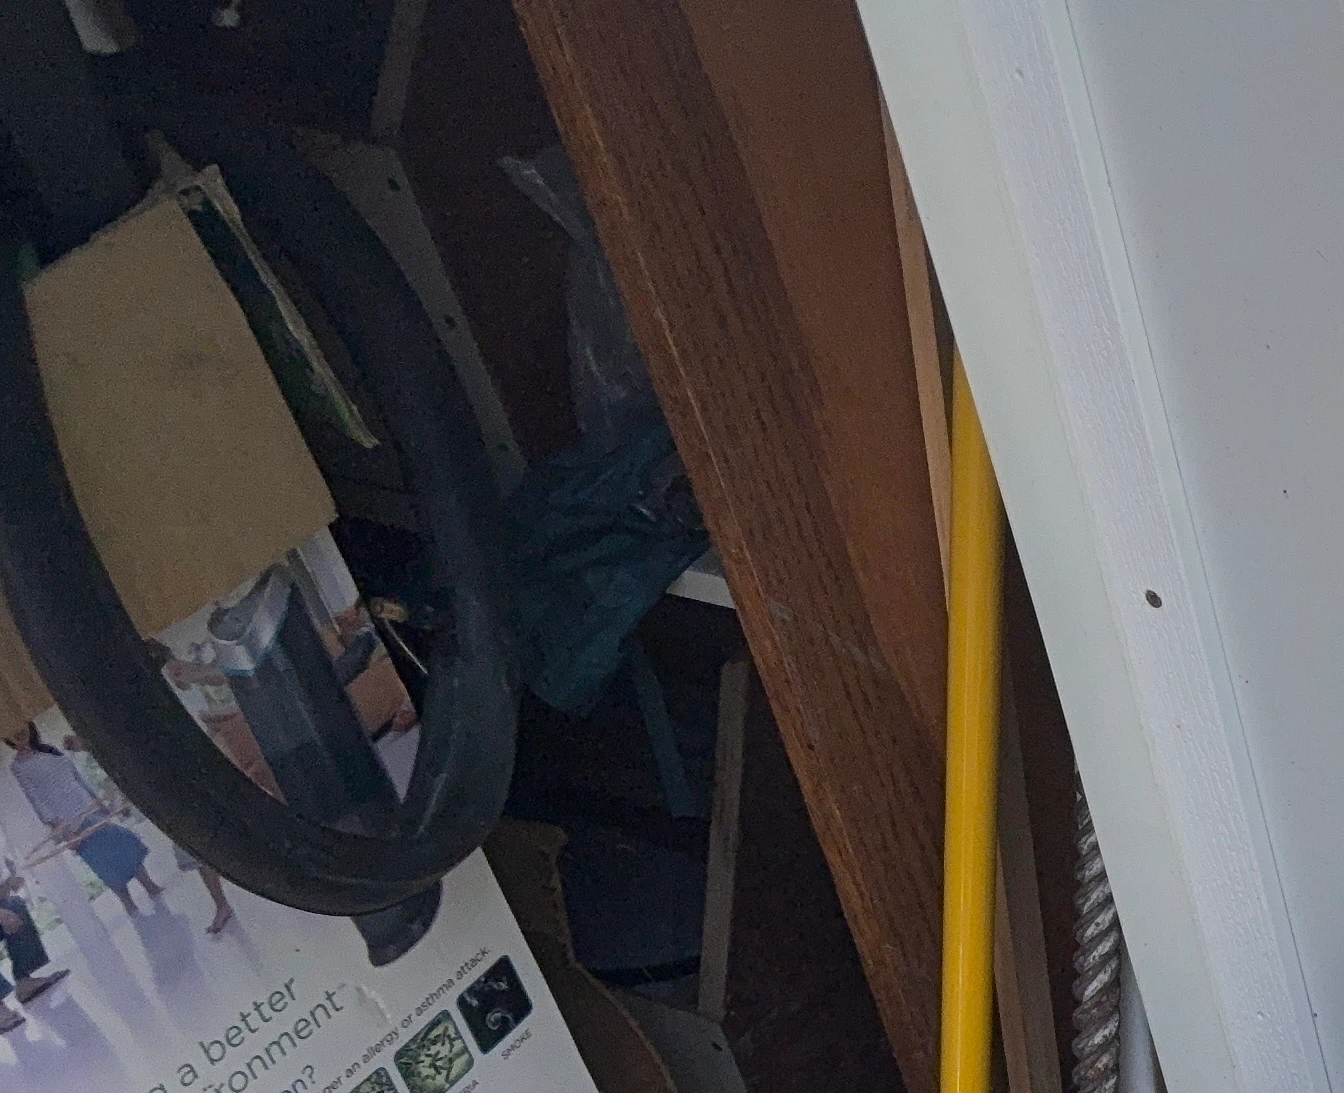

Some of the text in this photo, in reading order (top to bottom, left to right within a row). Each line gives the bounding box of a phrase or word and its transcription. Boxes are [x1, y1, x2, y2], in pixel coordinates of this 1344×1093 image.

[177, 1063, 199, 1087] a
[199, 977, 296, 1066] better
[345, 1062, 361, 1078] an
[362, 1027, 399, 1064] allergy
[401, 1014, 413, 1028] or
[415, 978, 455, 1016] asthma
[456, 947, 491, 980] attack.
[501, 1028, 532, 1060] SMOKE
